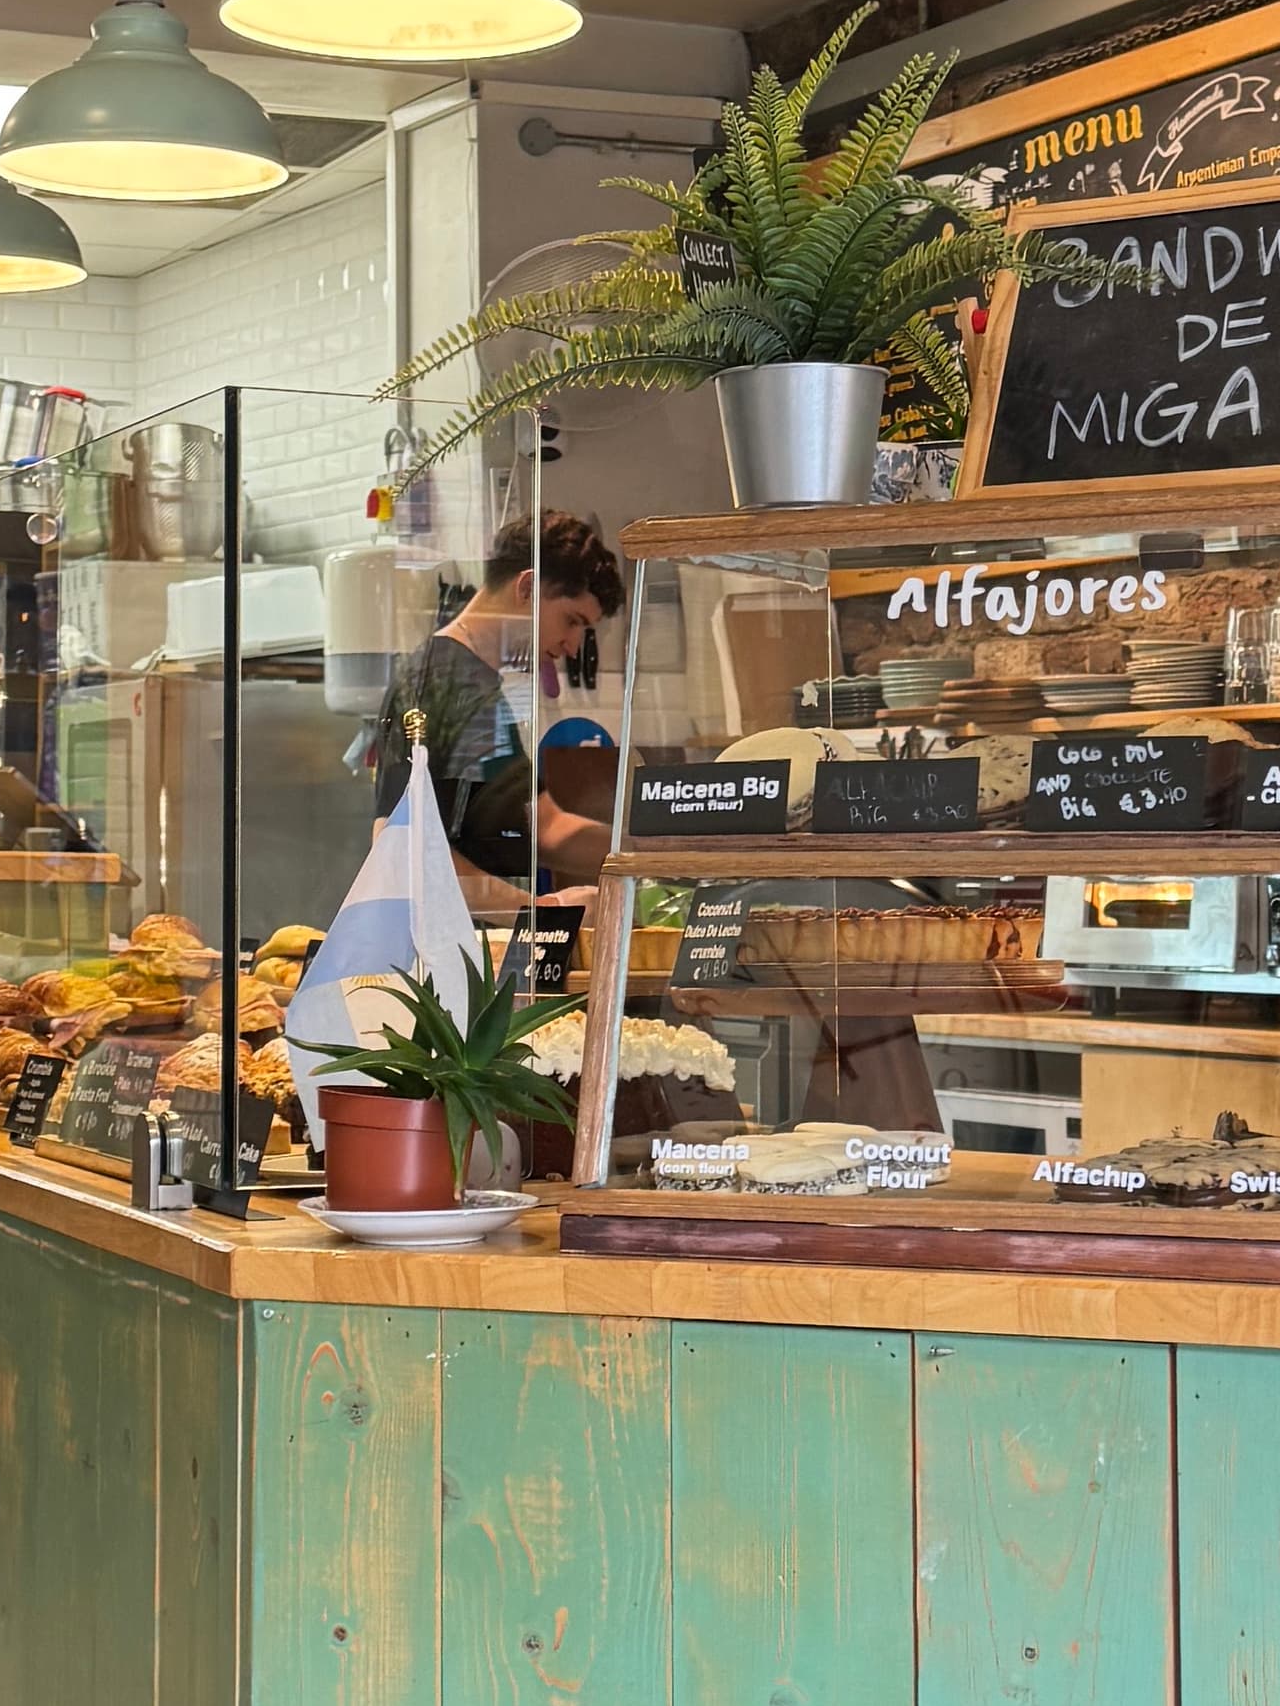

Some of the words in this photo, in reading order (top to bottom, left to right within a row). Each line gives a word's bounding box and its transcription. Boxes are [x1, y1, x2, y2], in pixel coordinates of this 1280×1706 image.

[1024, 103, 1145, 174] menu
[1176, 296, 1270, 362] DE
[1047, 366, 1263, 461] MIGA
[886, 564, 1167, 636] Alfajores
[640, 780, 736, 802] Maicena
[742, 776, 780, 800] Big
[670, 801, 705, 814] (corn
[707, 799, 744, 813] flour)
[651, 1138, 749, 1164] Maicena
[844, 1138, 952, 1166] Coconut
[865, 1163, 933, 1192] Flour
[1033, 1159, 1146, 1193] Alfachip
